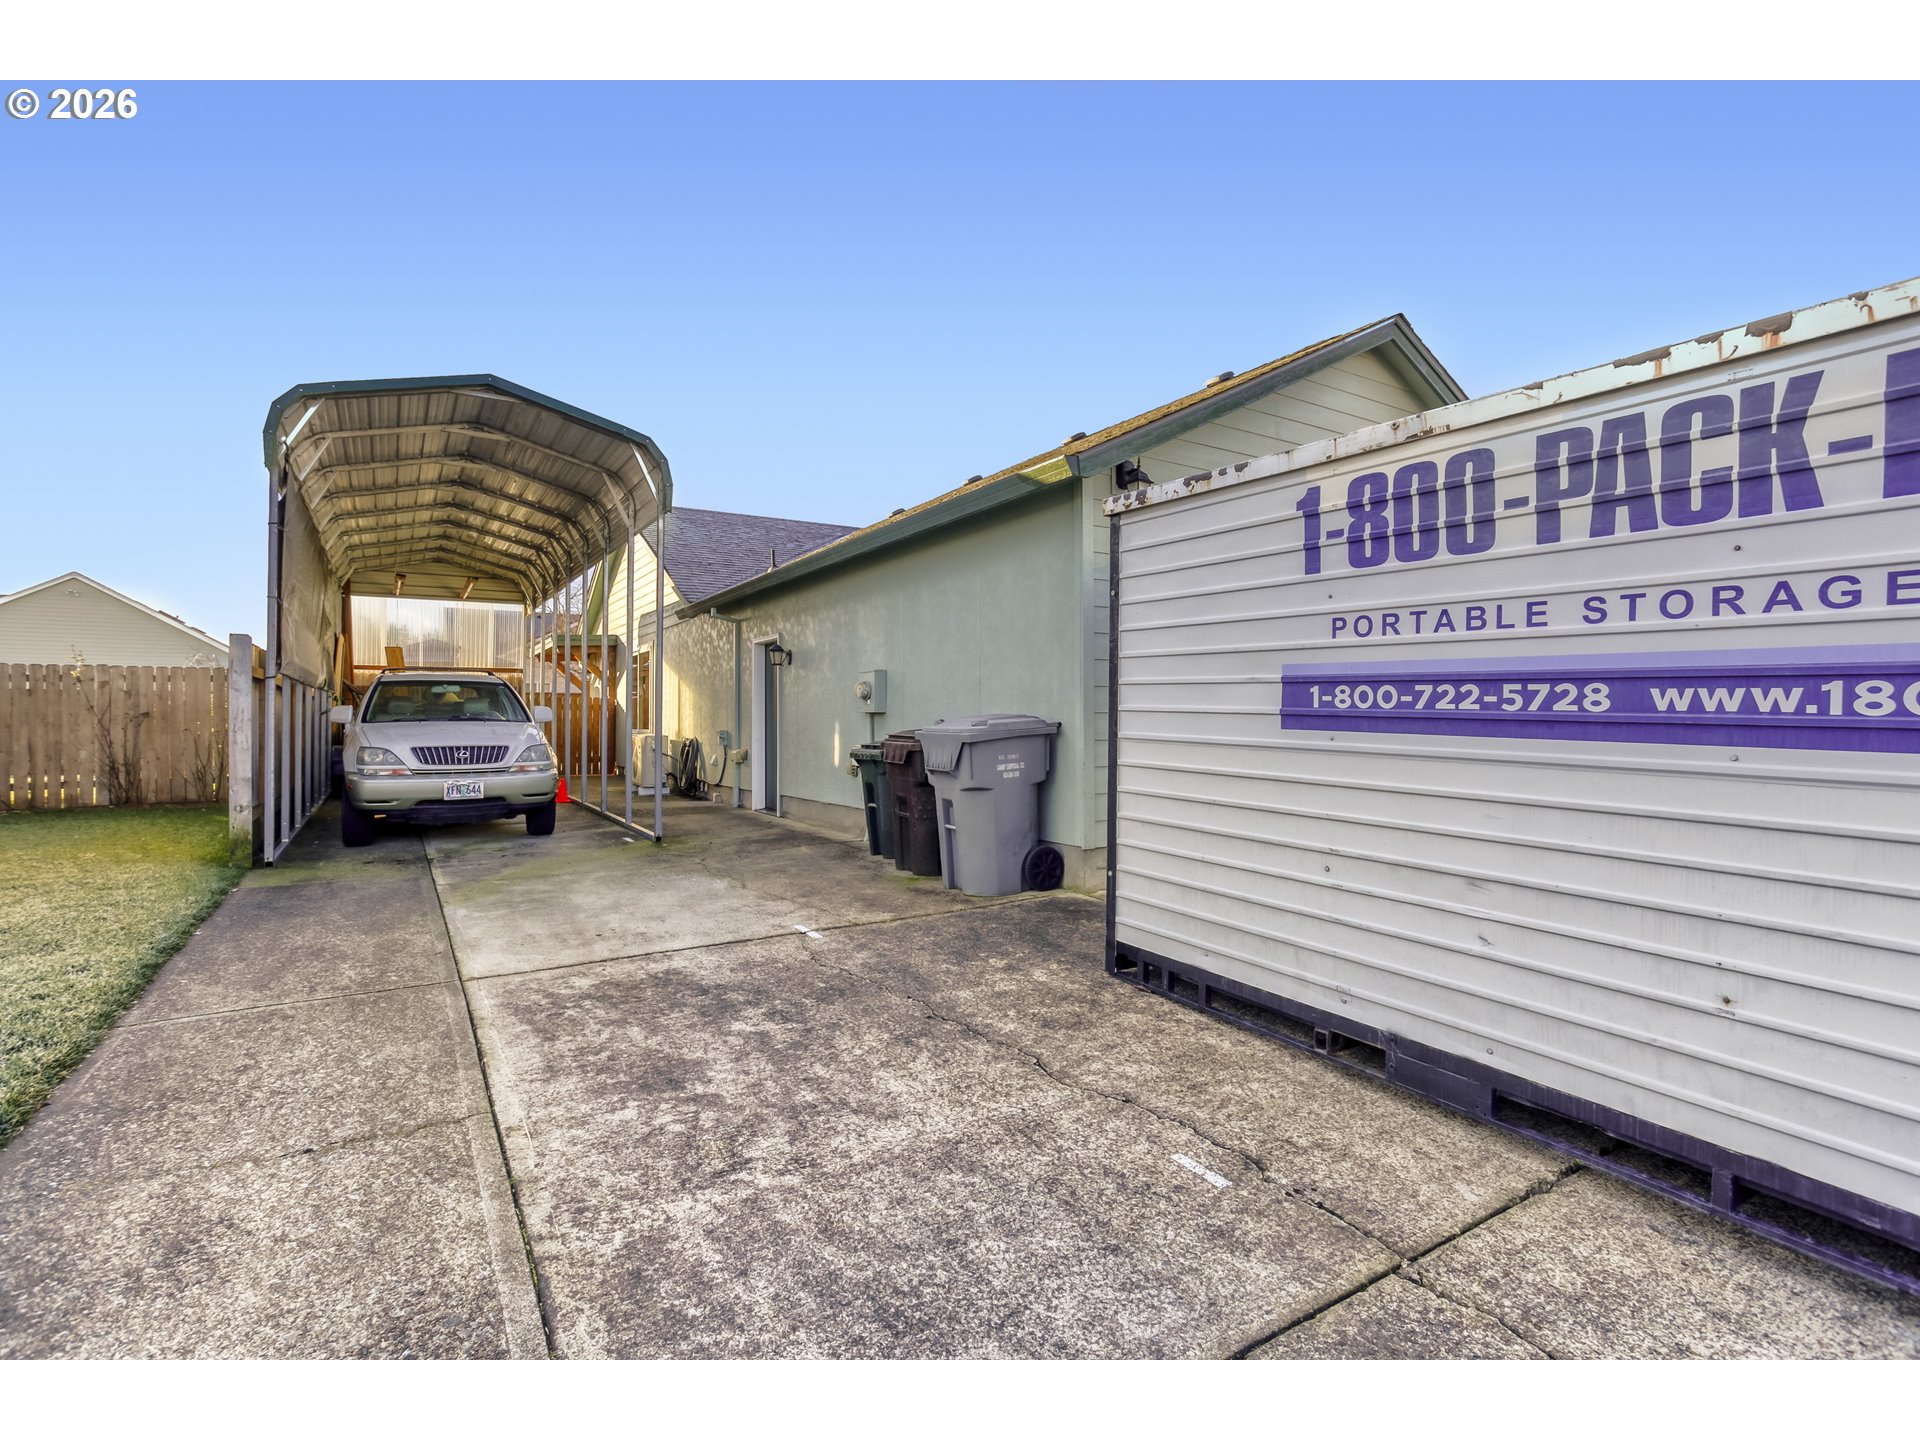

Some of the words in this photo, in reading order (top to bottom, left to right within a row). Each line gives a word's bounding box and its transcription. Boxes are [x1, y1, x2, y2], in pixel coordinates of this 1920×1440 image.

[1331, 600, 1549, 639] PORTABLE
[1582, 569, 1920, 625] STORAGE
[1309, 682, 1611, 712] 1-800-722-5728
[446, 784, 462, 796] XFN
[466, 784, 481, 795] 644
